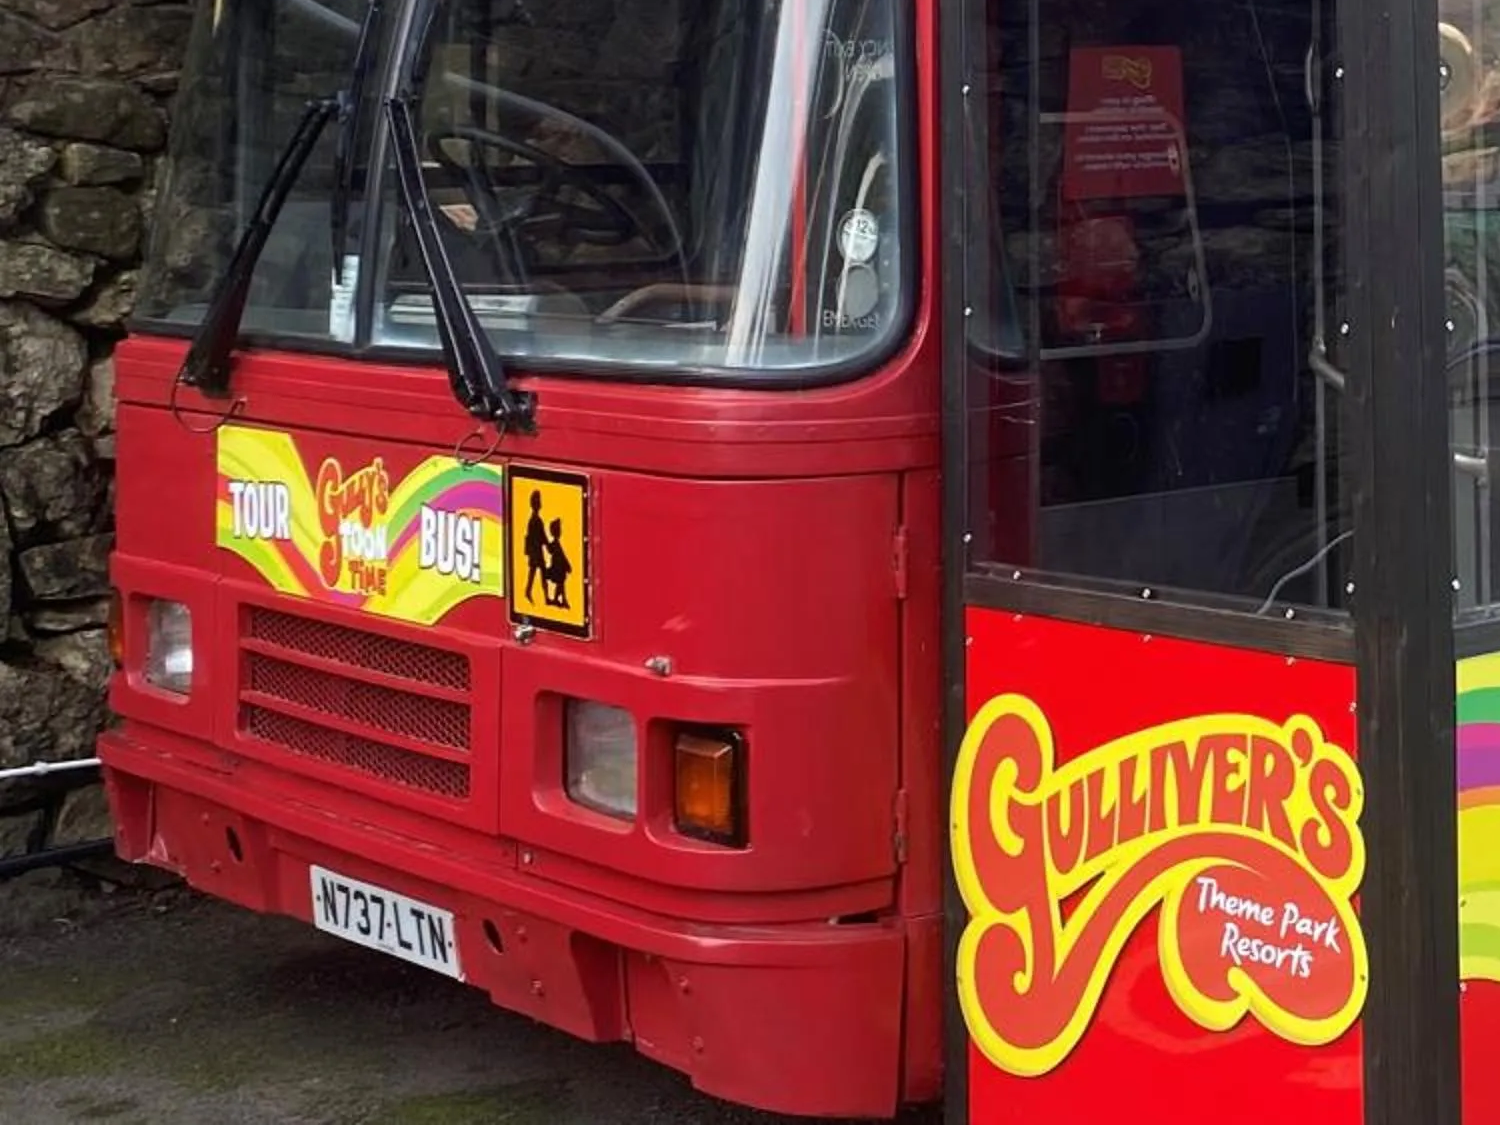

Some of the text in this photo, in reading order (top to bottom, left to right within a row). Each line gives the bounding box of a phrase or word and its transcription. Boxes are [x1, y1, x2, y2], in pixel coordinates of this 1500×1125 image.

[228, 480, 291, 541] TOUR
[338, 518, 388, 560] TOON
[418, 502, 482, 584] BUS!
[320, 875, 449, 964] N737 LTN
[958, 700, 1360, 1065] GULLIVER'S
[1196, 875, 1342, 953] Theme Park
[1219, 921, 1314, 979] Resorts
